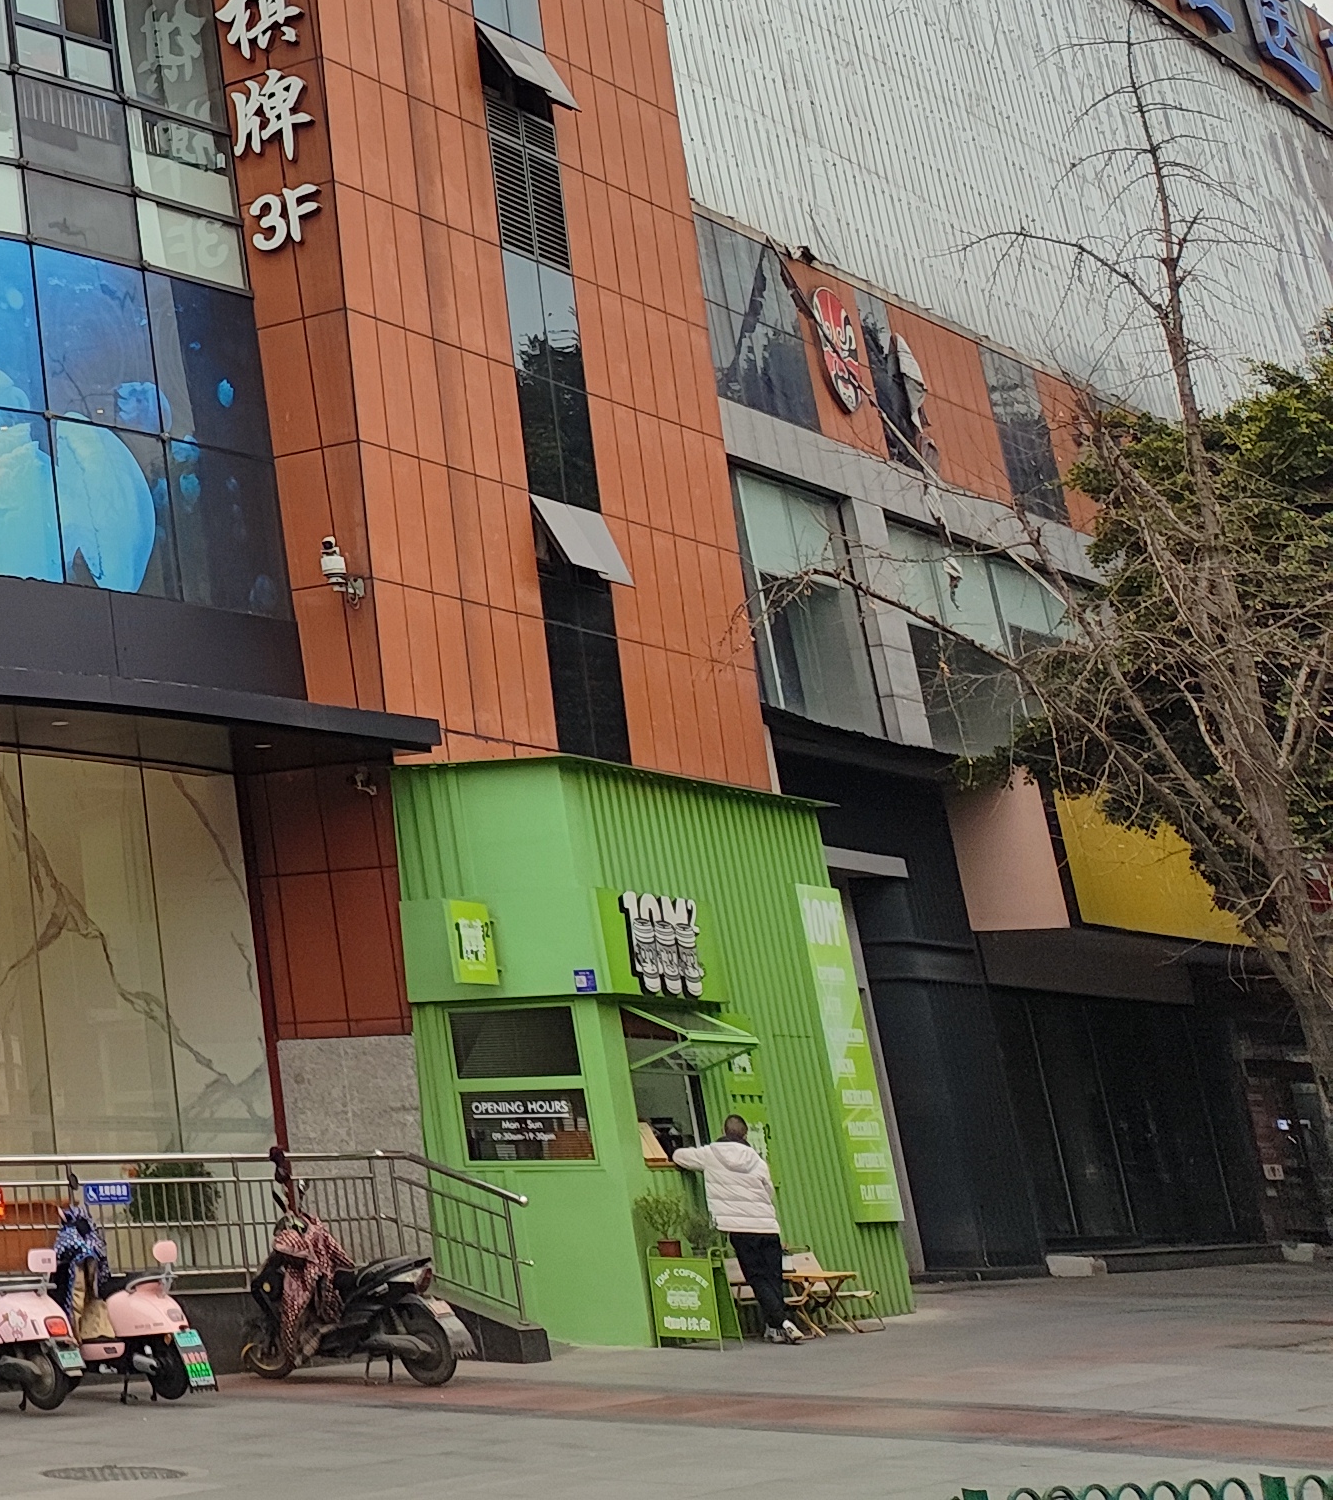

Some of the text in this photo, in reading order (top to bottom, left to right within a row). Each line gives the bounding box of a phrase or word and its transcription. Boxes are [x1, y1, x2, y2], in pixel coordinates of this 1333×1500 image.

[471, 1100, 569, 1114] OPENING HOURS
[501, 1119, 521, 1129] Mon
[527, 1119, 544, 1130] Sun
[673, 1268, 710, 1289] COFFEE
